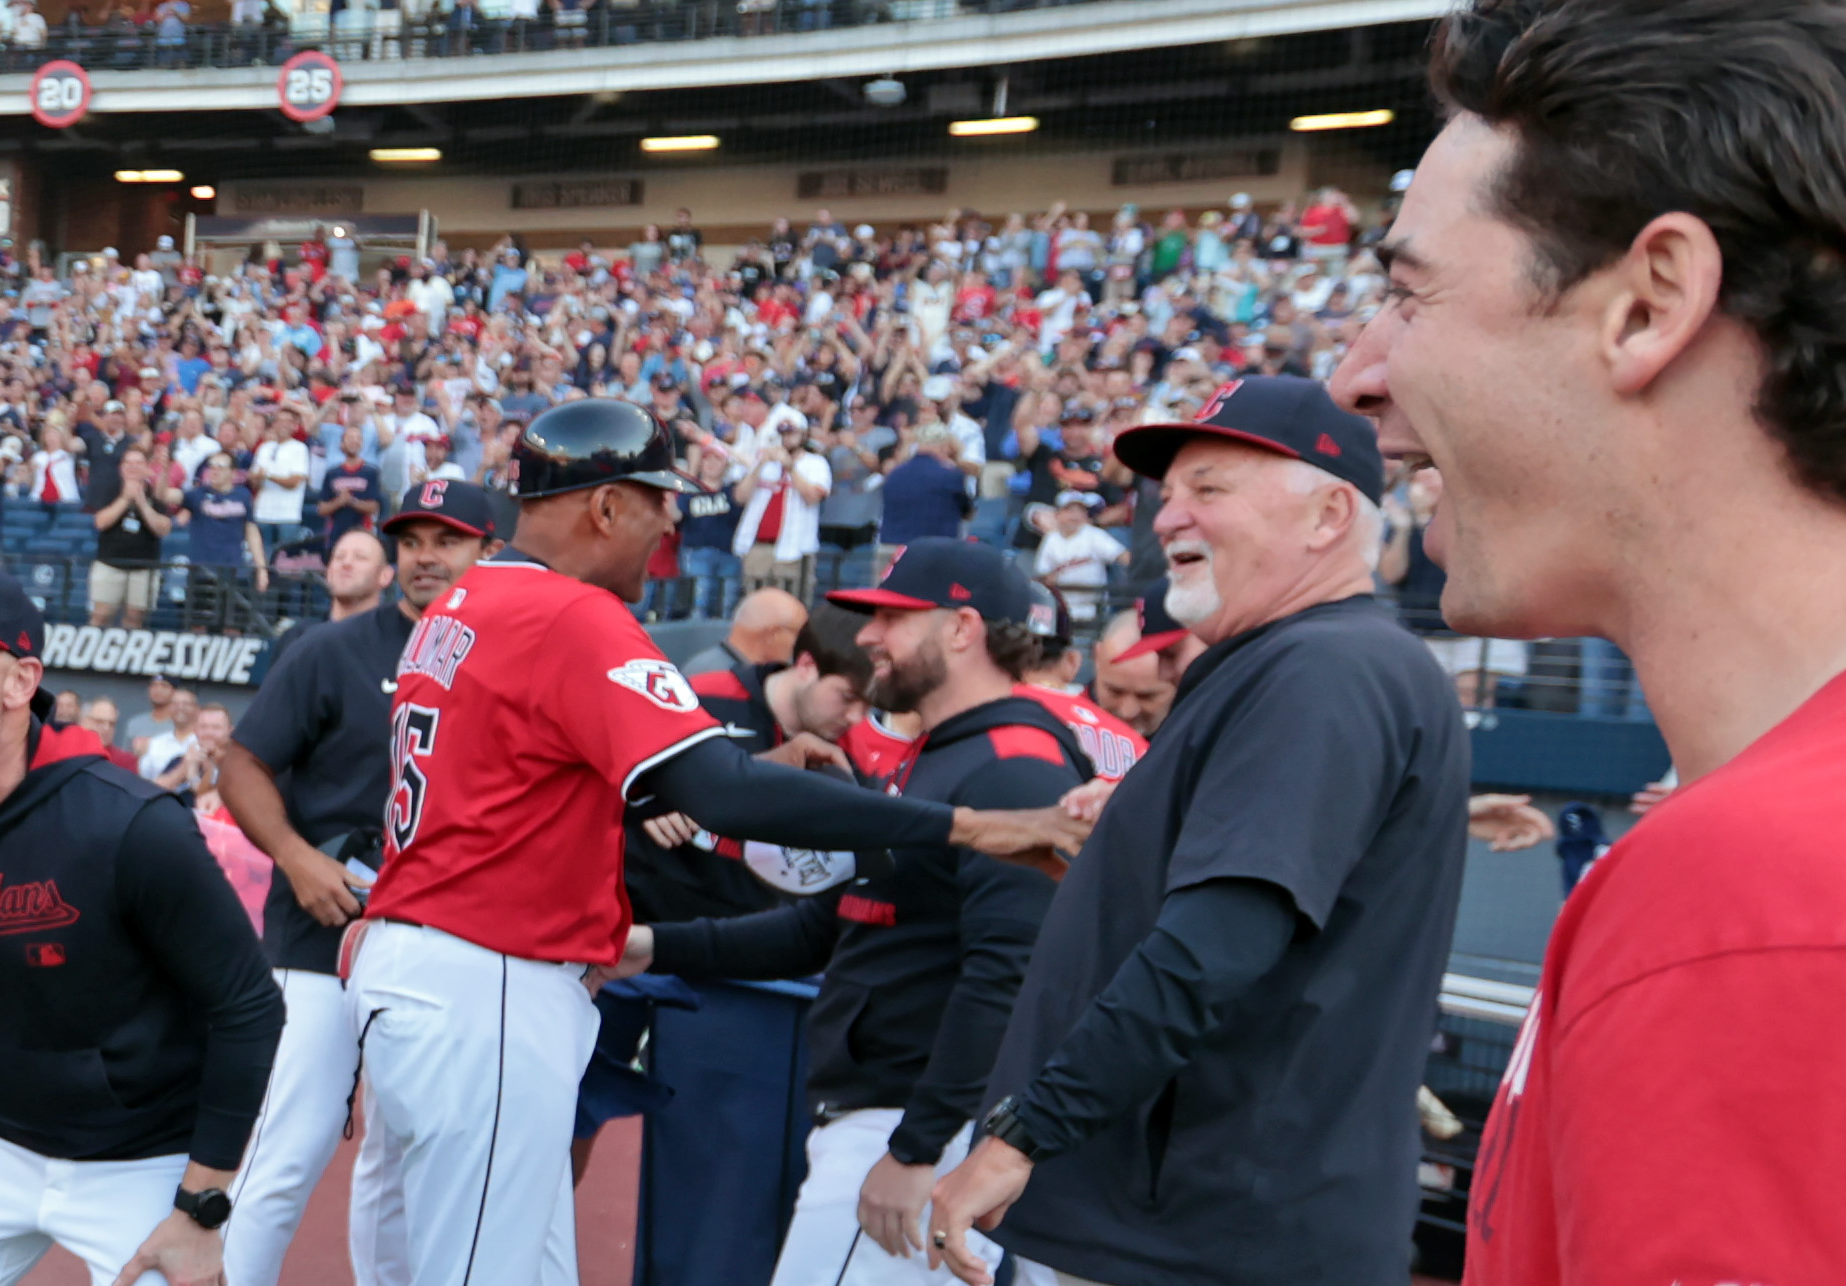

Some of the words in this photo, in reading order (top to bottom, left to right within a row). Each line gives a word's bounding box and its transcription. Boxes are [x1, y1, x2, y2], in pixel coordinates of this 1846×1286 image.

[37, 77, 83, 110] 20
[285, 68, 334, 104] 25
[421, 479, 449, 508] C
